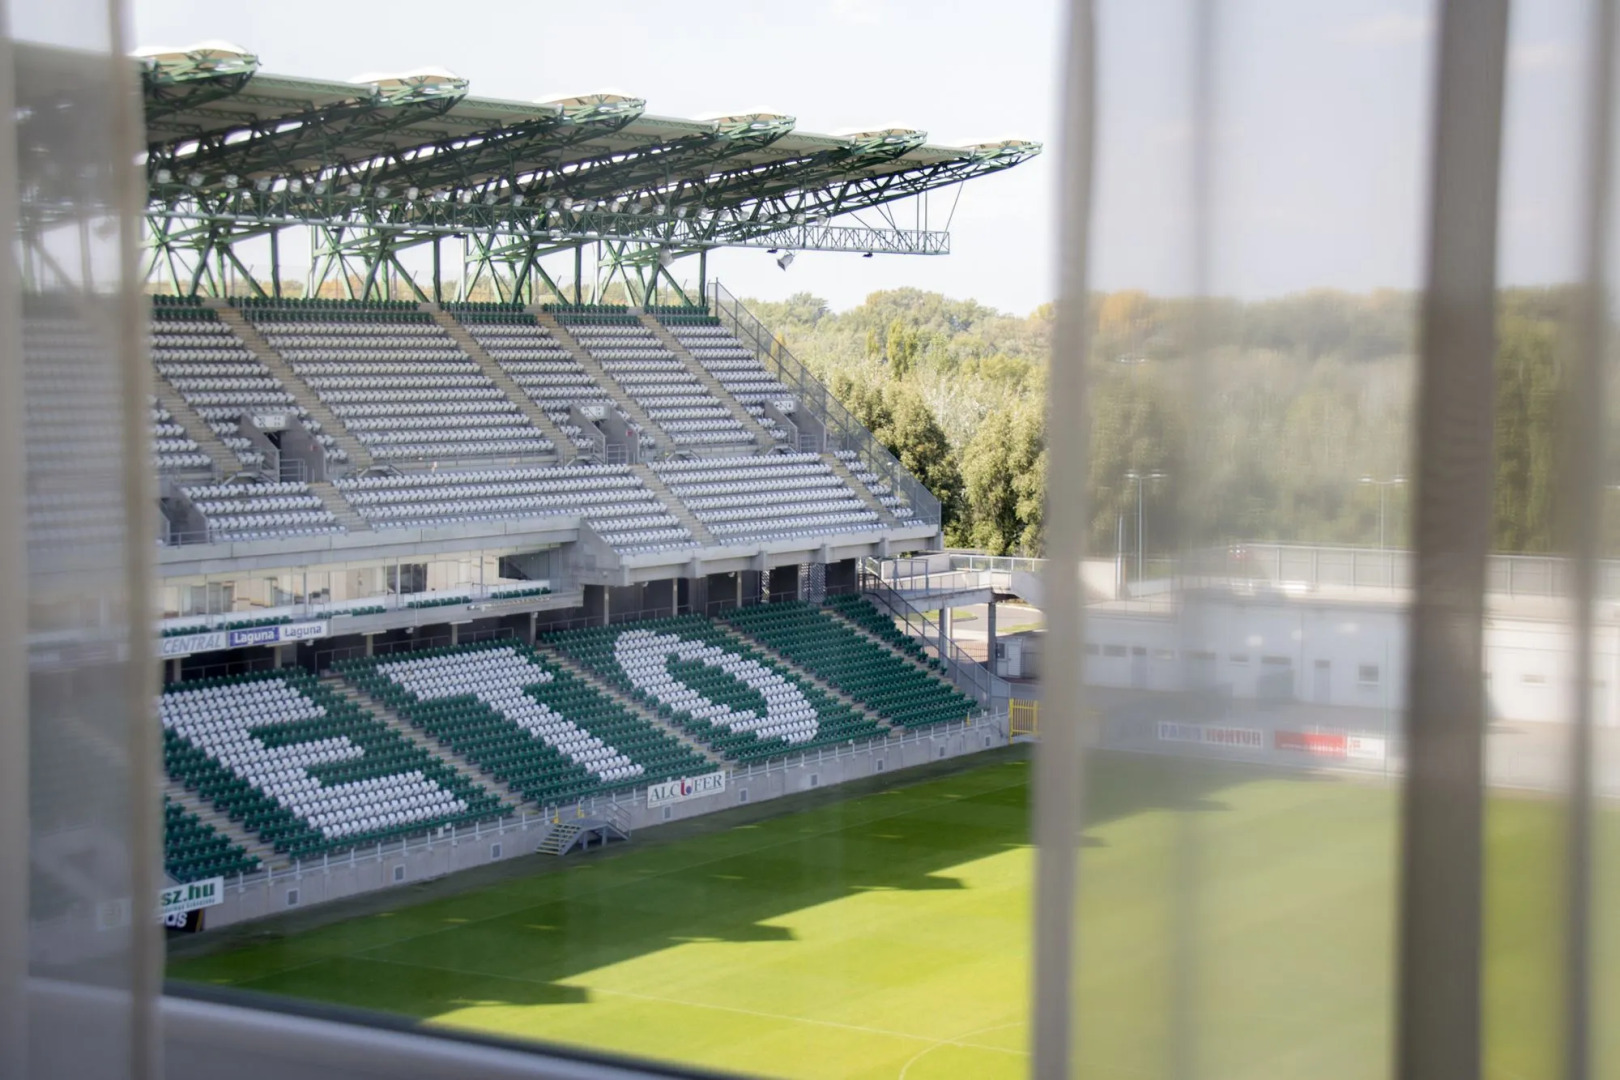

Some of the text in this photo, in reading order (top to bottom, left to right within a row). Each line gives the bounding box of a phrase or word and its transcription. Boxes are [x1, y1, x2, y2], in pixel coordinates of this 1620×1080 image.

[235, 629, 275, 645] Laguna
[284, 623, 322, 638] Laguna
[163, 634, 222, 654] CENTRAL
